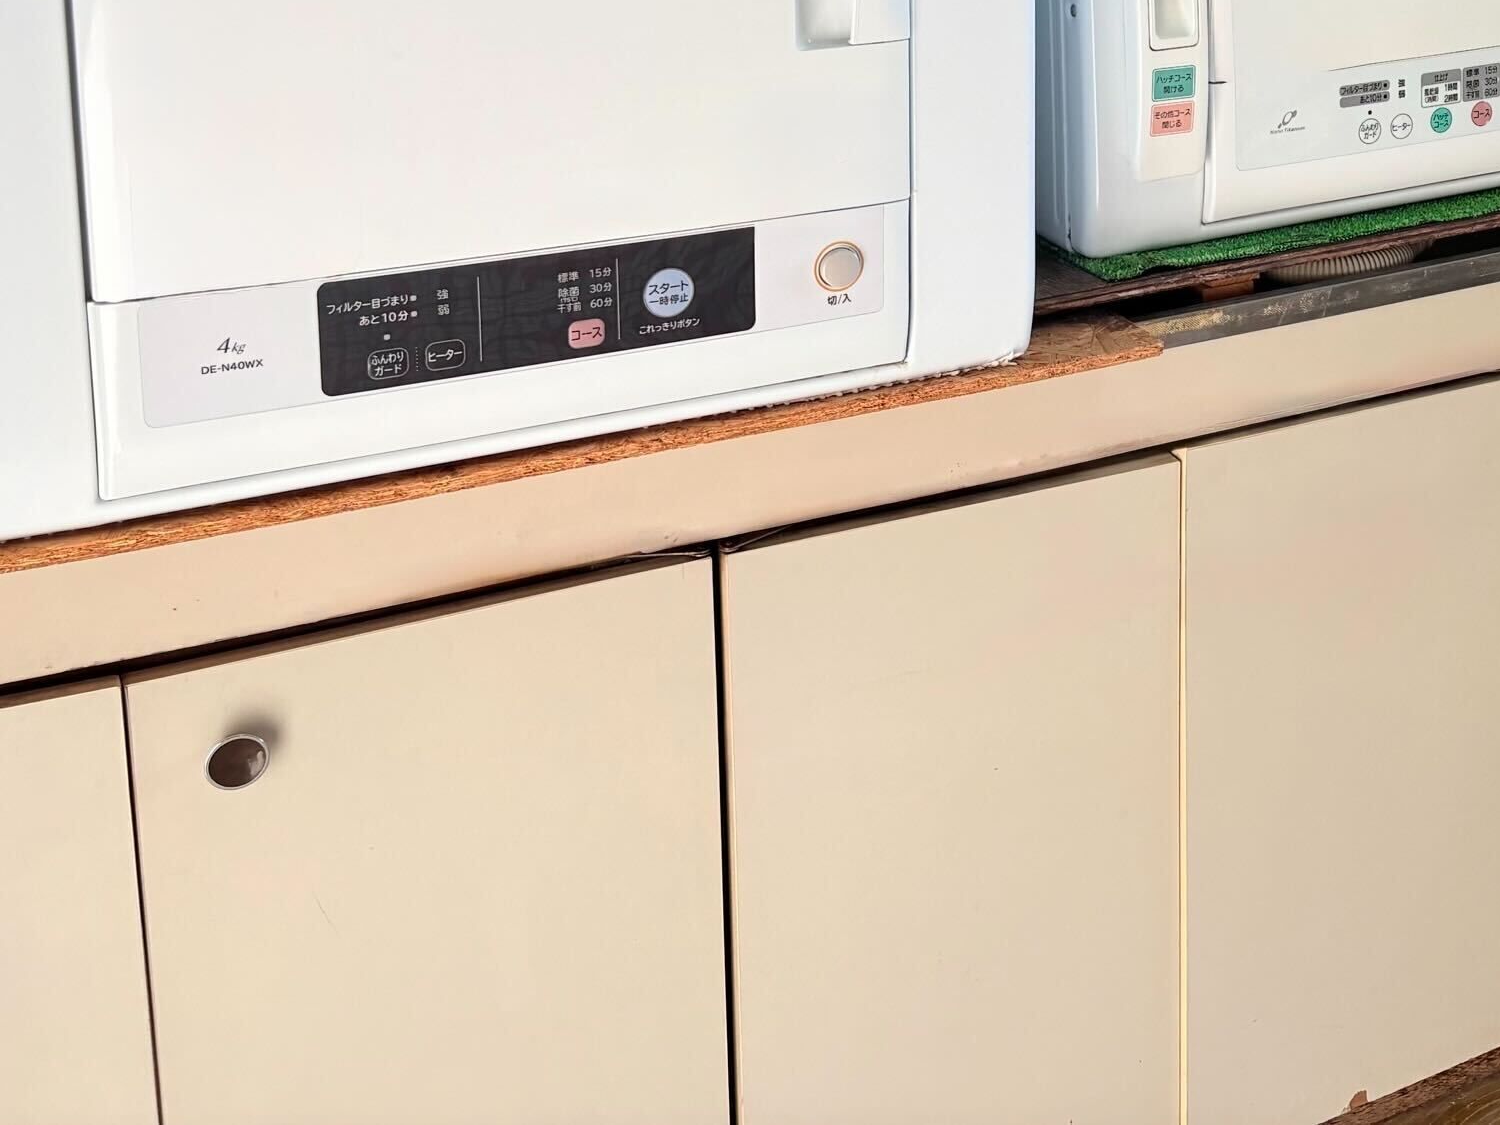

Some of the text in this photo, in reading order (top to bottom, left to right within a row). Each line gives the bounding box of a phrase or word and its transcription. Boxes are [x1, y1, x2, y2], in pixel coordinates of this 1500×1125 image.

[1155, 72, 1192, 84] ハッチコース
[1163, 84, 1184, 94] 開ける
[1154, 107, 1191, 120] その他コース
[1433, 112, 1449, 121] ハッチ
[1473, 108, 1491, 119] コース
[1392, 122, 1411, 132] ヒーター
[1433, 119, 1449, 129] コース
[557, 271, 579, 284] 標準
[589, 266, 612, 279] 15分
[557, 286, 580, 299] 除菌
[589, 282, 613, 294] 30分
[648, 279, 689, 296] スタート
[436, 289, 449, 301] 強
[648, 294, 689, 306] 一時停止
[827, 293, 852, 306] 切/入
[326, 294, 409, 315] フィルター目づまり
[590, 297, 613, 309] 60分
[437, 304, 450, 316] 弱
[359, 310, 409, 327] あと10分
[639, 317, 701, 335] これっきりボタン
[571, 325, 602, 342] コース
[371, 351, 404, 366] ふんわり
[428, 349, 463, 363] ヒーター
[200, 358, 264, 375] DE-N40WX
[374, 364, 402, 377] ガード
